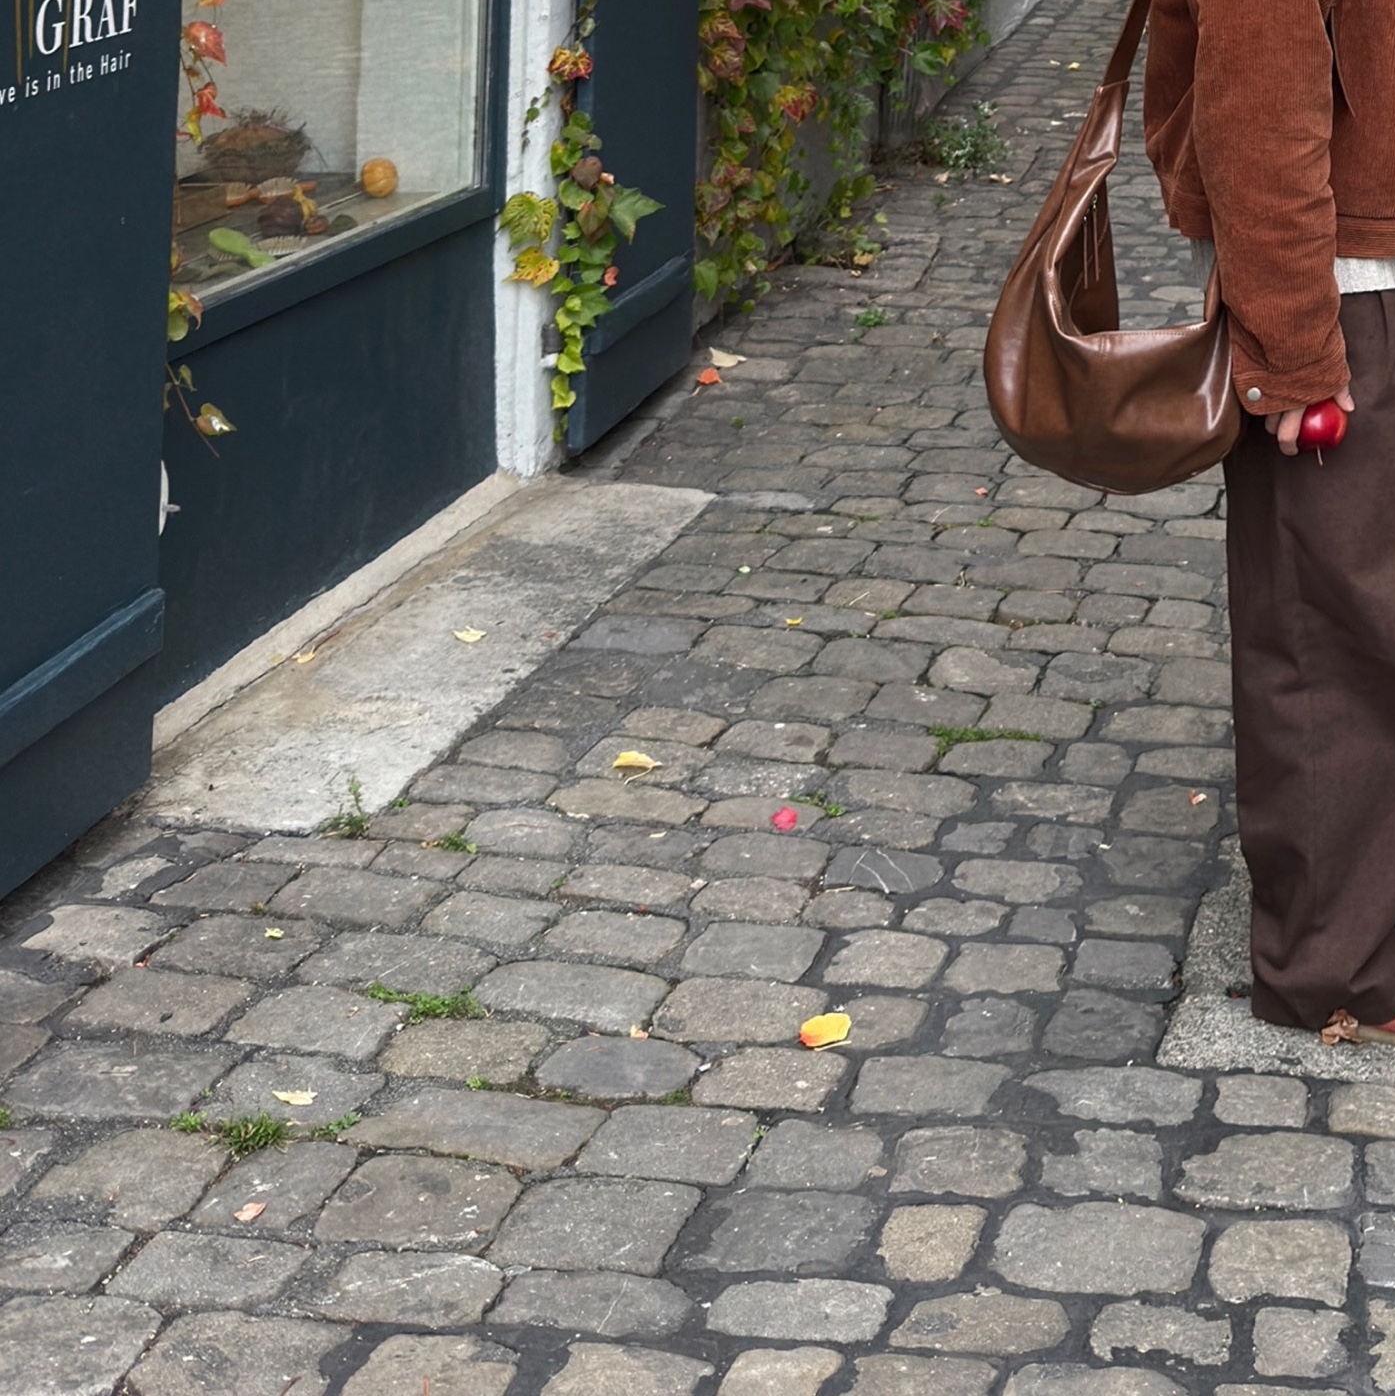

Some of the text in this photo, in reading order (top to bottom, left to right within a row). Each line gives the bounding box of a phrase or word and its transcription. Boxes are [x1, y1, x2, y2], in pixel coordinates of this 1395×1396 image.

[25, 76, 39, 98] is
[46, 70, 61, 92] in
[69, 62, 93, 84] the
[100, 50, 132, 76] Hair
